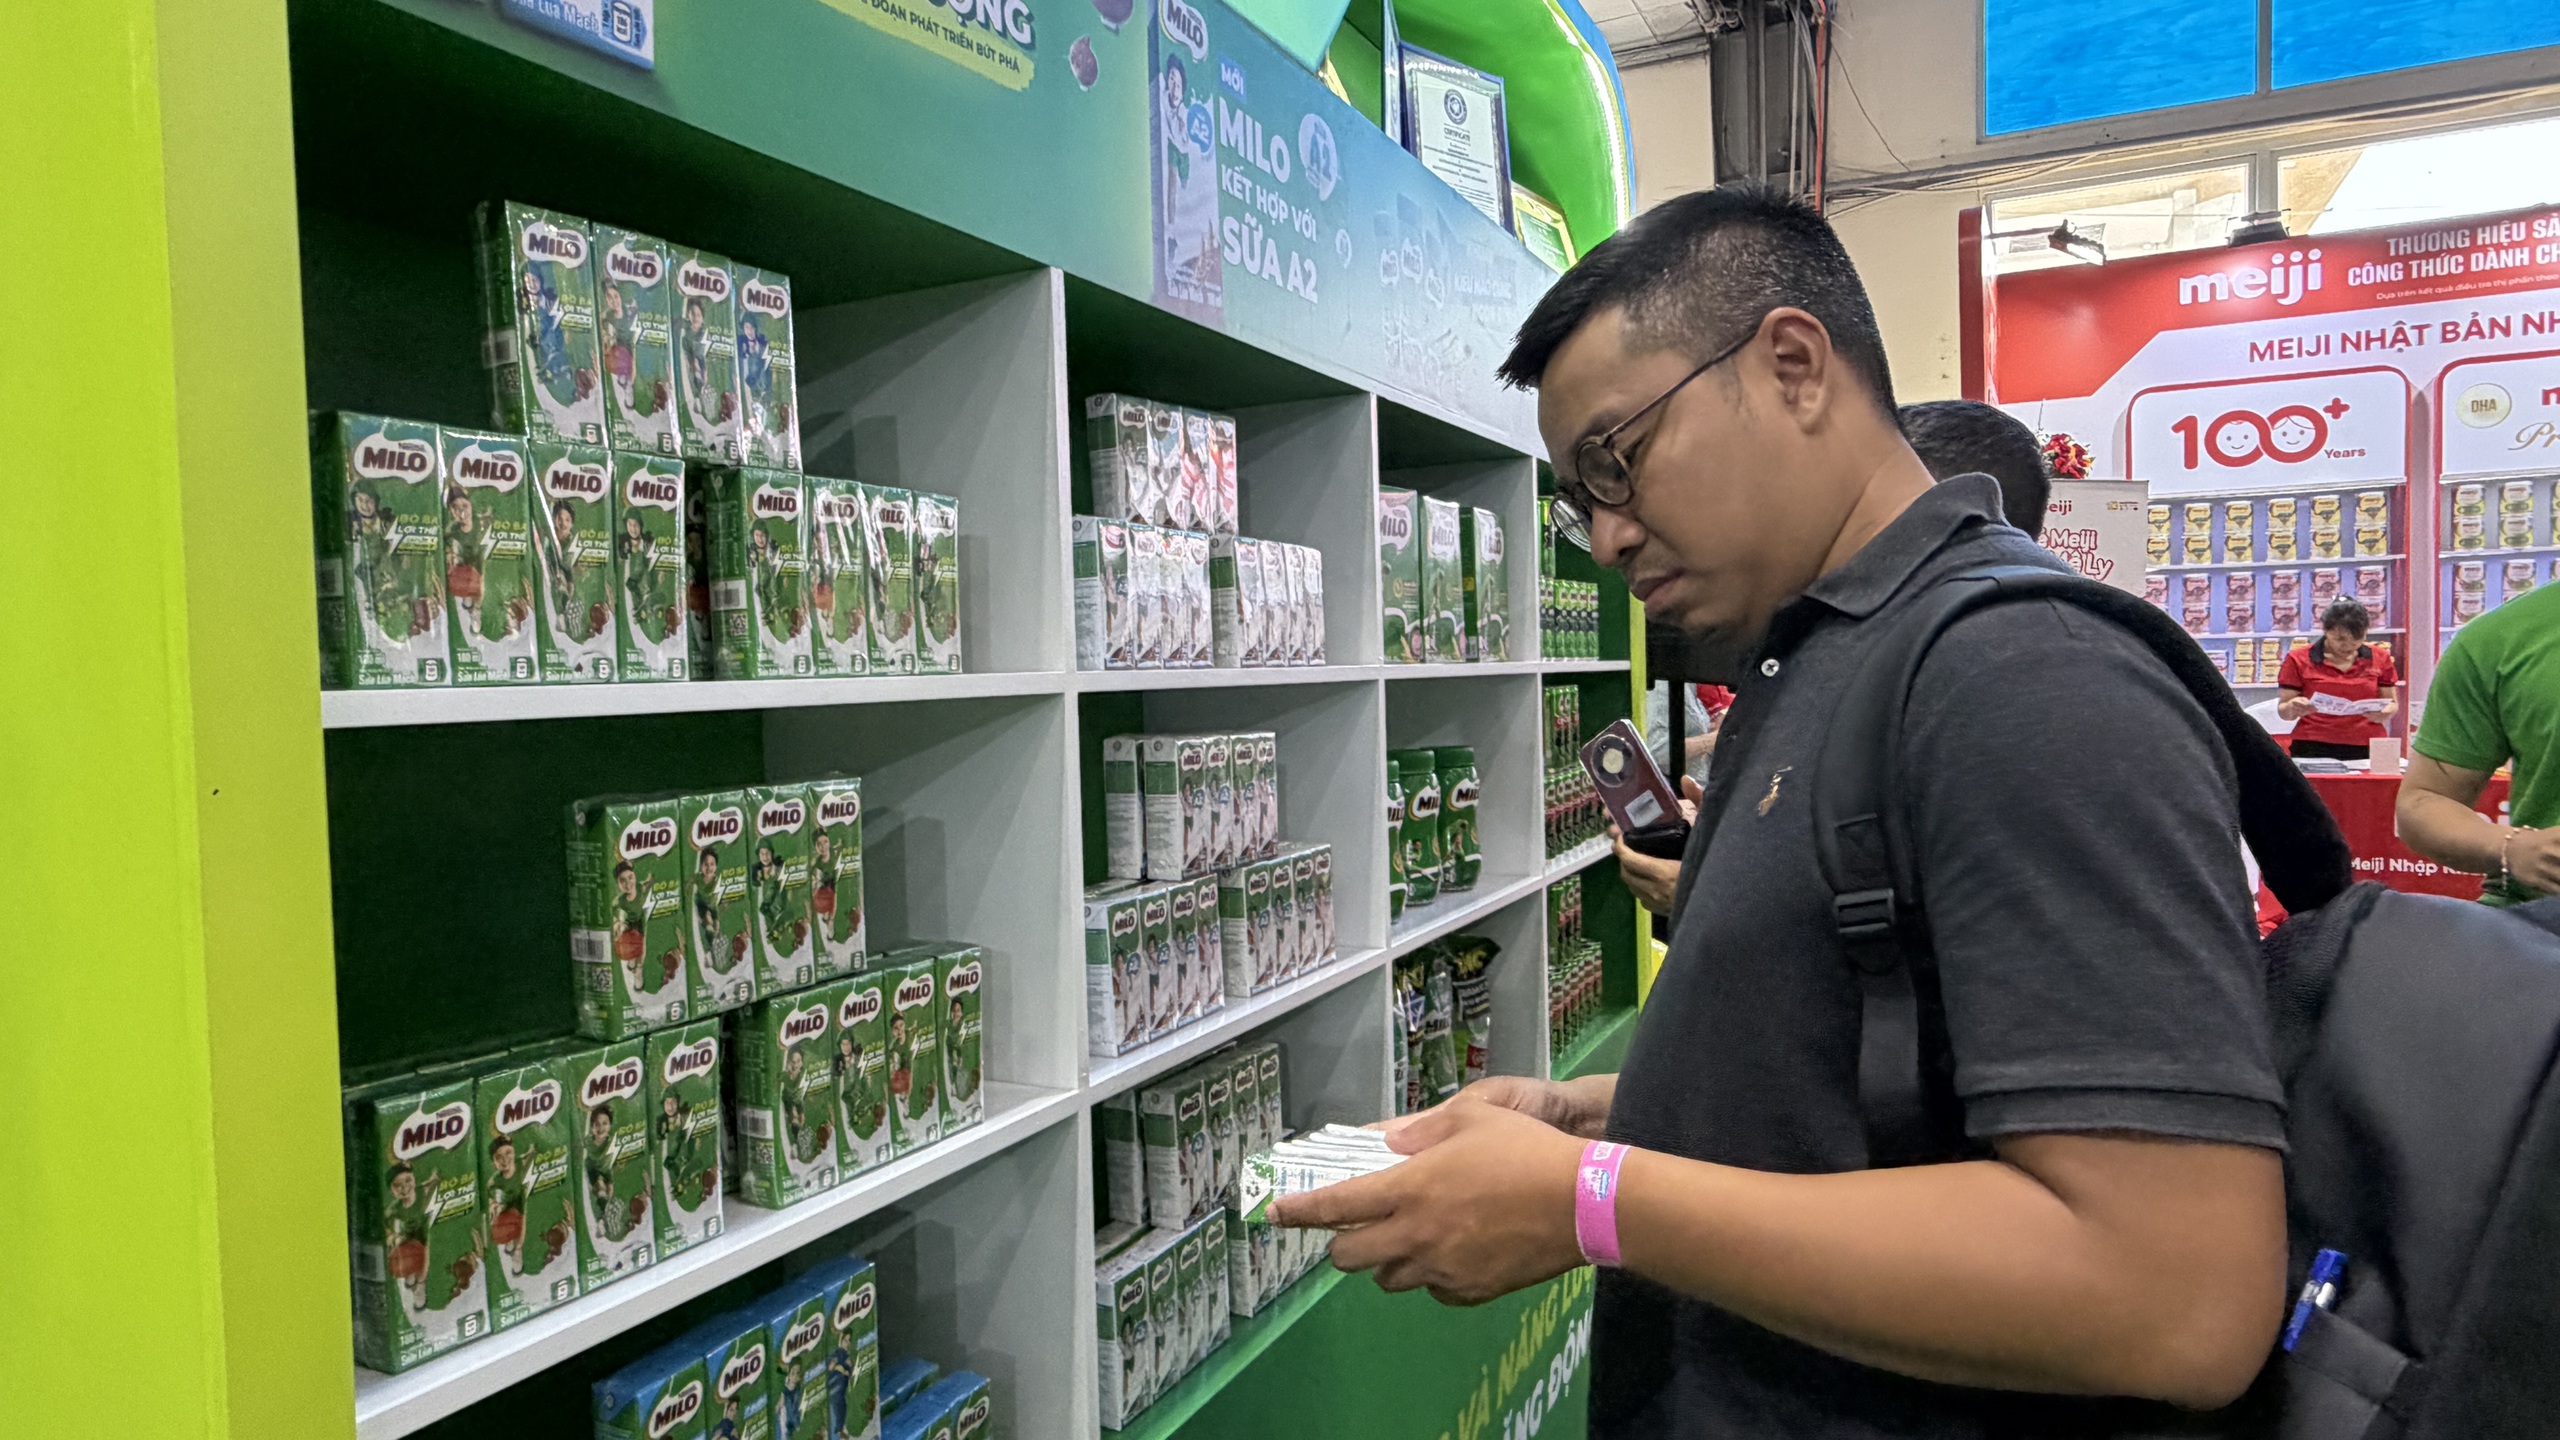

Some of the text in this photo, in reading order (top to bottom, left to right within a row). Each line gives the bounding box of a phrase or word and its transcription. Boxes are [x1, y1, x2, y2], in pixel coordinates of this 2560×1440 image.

[1167, 0, 1204, 50] MILO
[909, 11, 940, 37] PHÁT
[942, 26, 974, 51] TRIỂN
[976, 42, 996, 63] BỨT
[998, 52, 1021, 73] PHÁ
[1220, 63, 1245, 96] MỚI
[1218, 96, 1291, 183] MILO
[1221, 164, 1317, 242] KẾT HỢP VỚI
[528, 233, 582, 260] MILO
[2387, 229, 2470, 257] THƯƠNG
[2477, 220, 2526, 247] HIỆU
[611, 252, 658, 280] MILO
[1222, 213, 1284, 288] SỮA
[1286, 251, 1318, 304] A2
[2348, 262, 2404, 287] CÔNG
[2408, 253, 2465, 279] THỨC
[2470, 247, 2530, 272] DÀNH
[683, 269, 726, 295] MILO
[2179, 248, 2322, 306] meiji
[746, 288, 785, 312] MILO
[2249, 333, 2331, 363] MEIJI
[2340, 321, 2432, 354] NHẬT
[2439, 312, 2513, 344] BẢN
[2471, 398, 2497, 413] DHA
[362, 446, 427, 473] MILO
[2324, 447, 2367, 460] Years
[460, 457, 517, 482] MILO
[551, 470, 603, 494] MILO
[631, 479, 678, 502] MILO
[758, 494, 797, 513] MILO
[2048, 500, 2073, 516] eiji
[761, 809, 801, 829] MILO
[820, 801, 857, 820] MILO
[625, 829, 672, 851] MILO
[696, 818, 739, 840] MILO
[2389, 858, 2439, 877] Nhập
[898, 983, 931, 1006] MILO
[948, 970, 980, 992] MILO
[843, 996, 879, 1021] MILO
[784, 1014, 825, 1040] MILO
[669, 1049, 713, 1077] MILO
[588, 1068, 639, 1099] MILO
[502, 1091, 556, 1125] MILO
[401, 1115, 465, 1152] MILO
[838, 1292, 871, 1324] MILO
[786, 1323, 821, 1357] MILO
[723, 1353, 761, 1392] MILO
[654, 1392, 698, 1433] MILO
